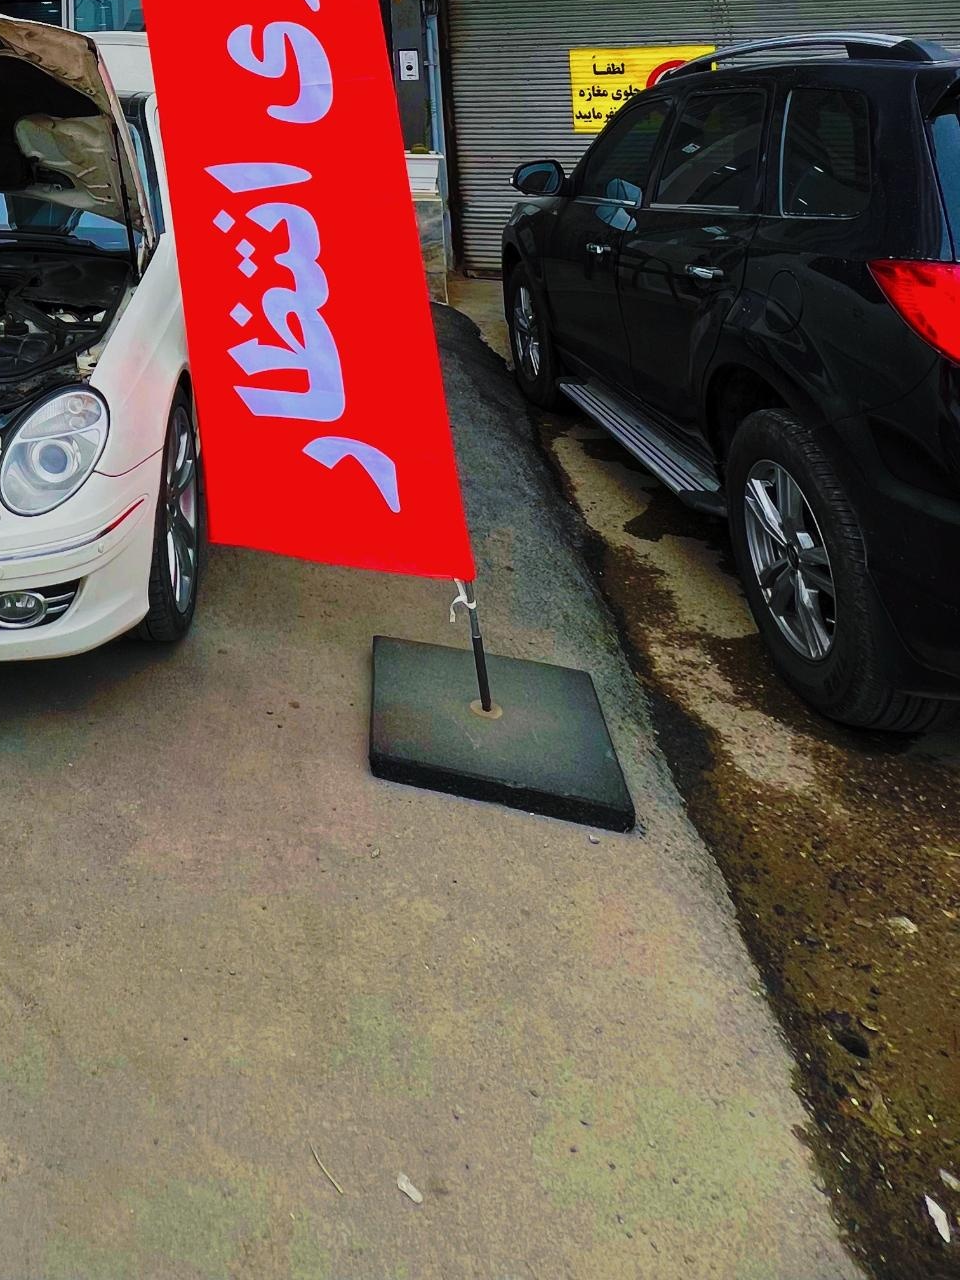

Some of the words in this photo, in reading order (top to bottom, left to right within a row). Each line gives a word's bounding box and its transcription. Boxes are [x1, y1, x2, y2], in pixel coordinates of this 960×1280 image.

[592, 55, 625, 76] لطفاً
[578, 85, 608, 102] مغازه
[203, 162, 401, 514] انتظار
